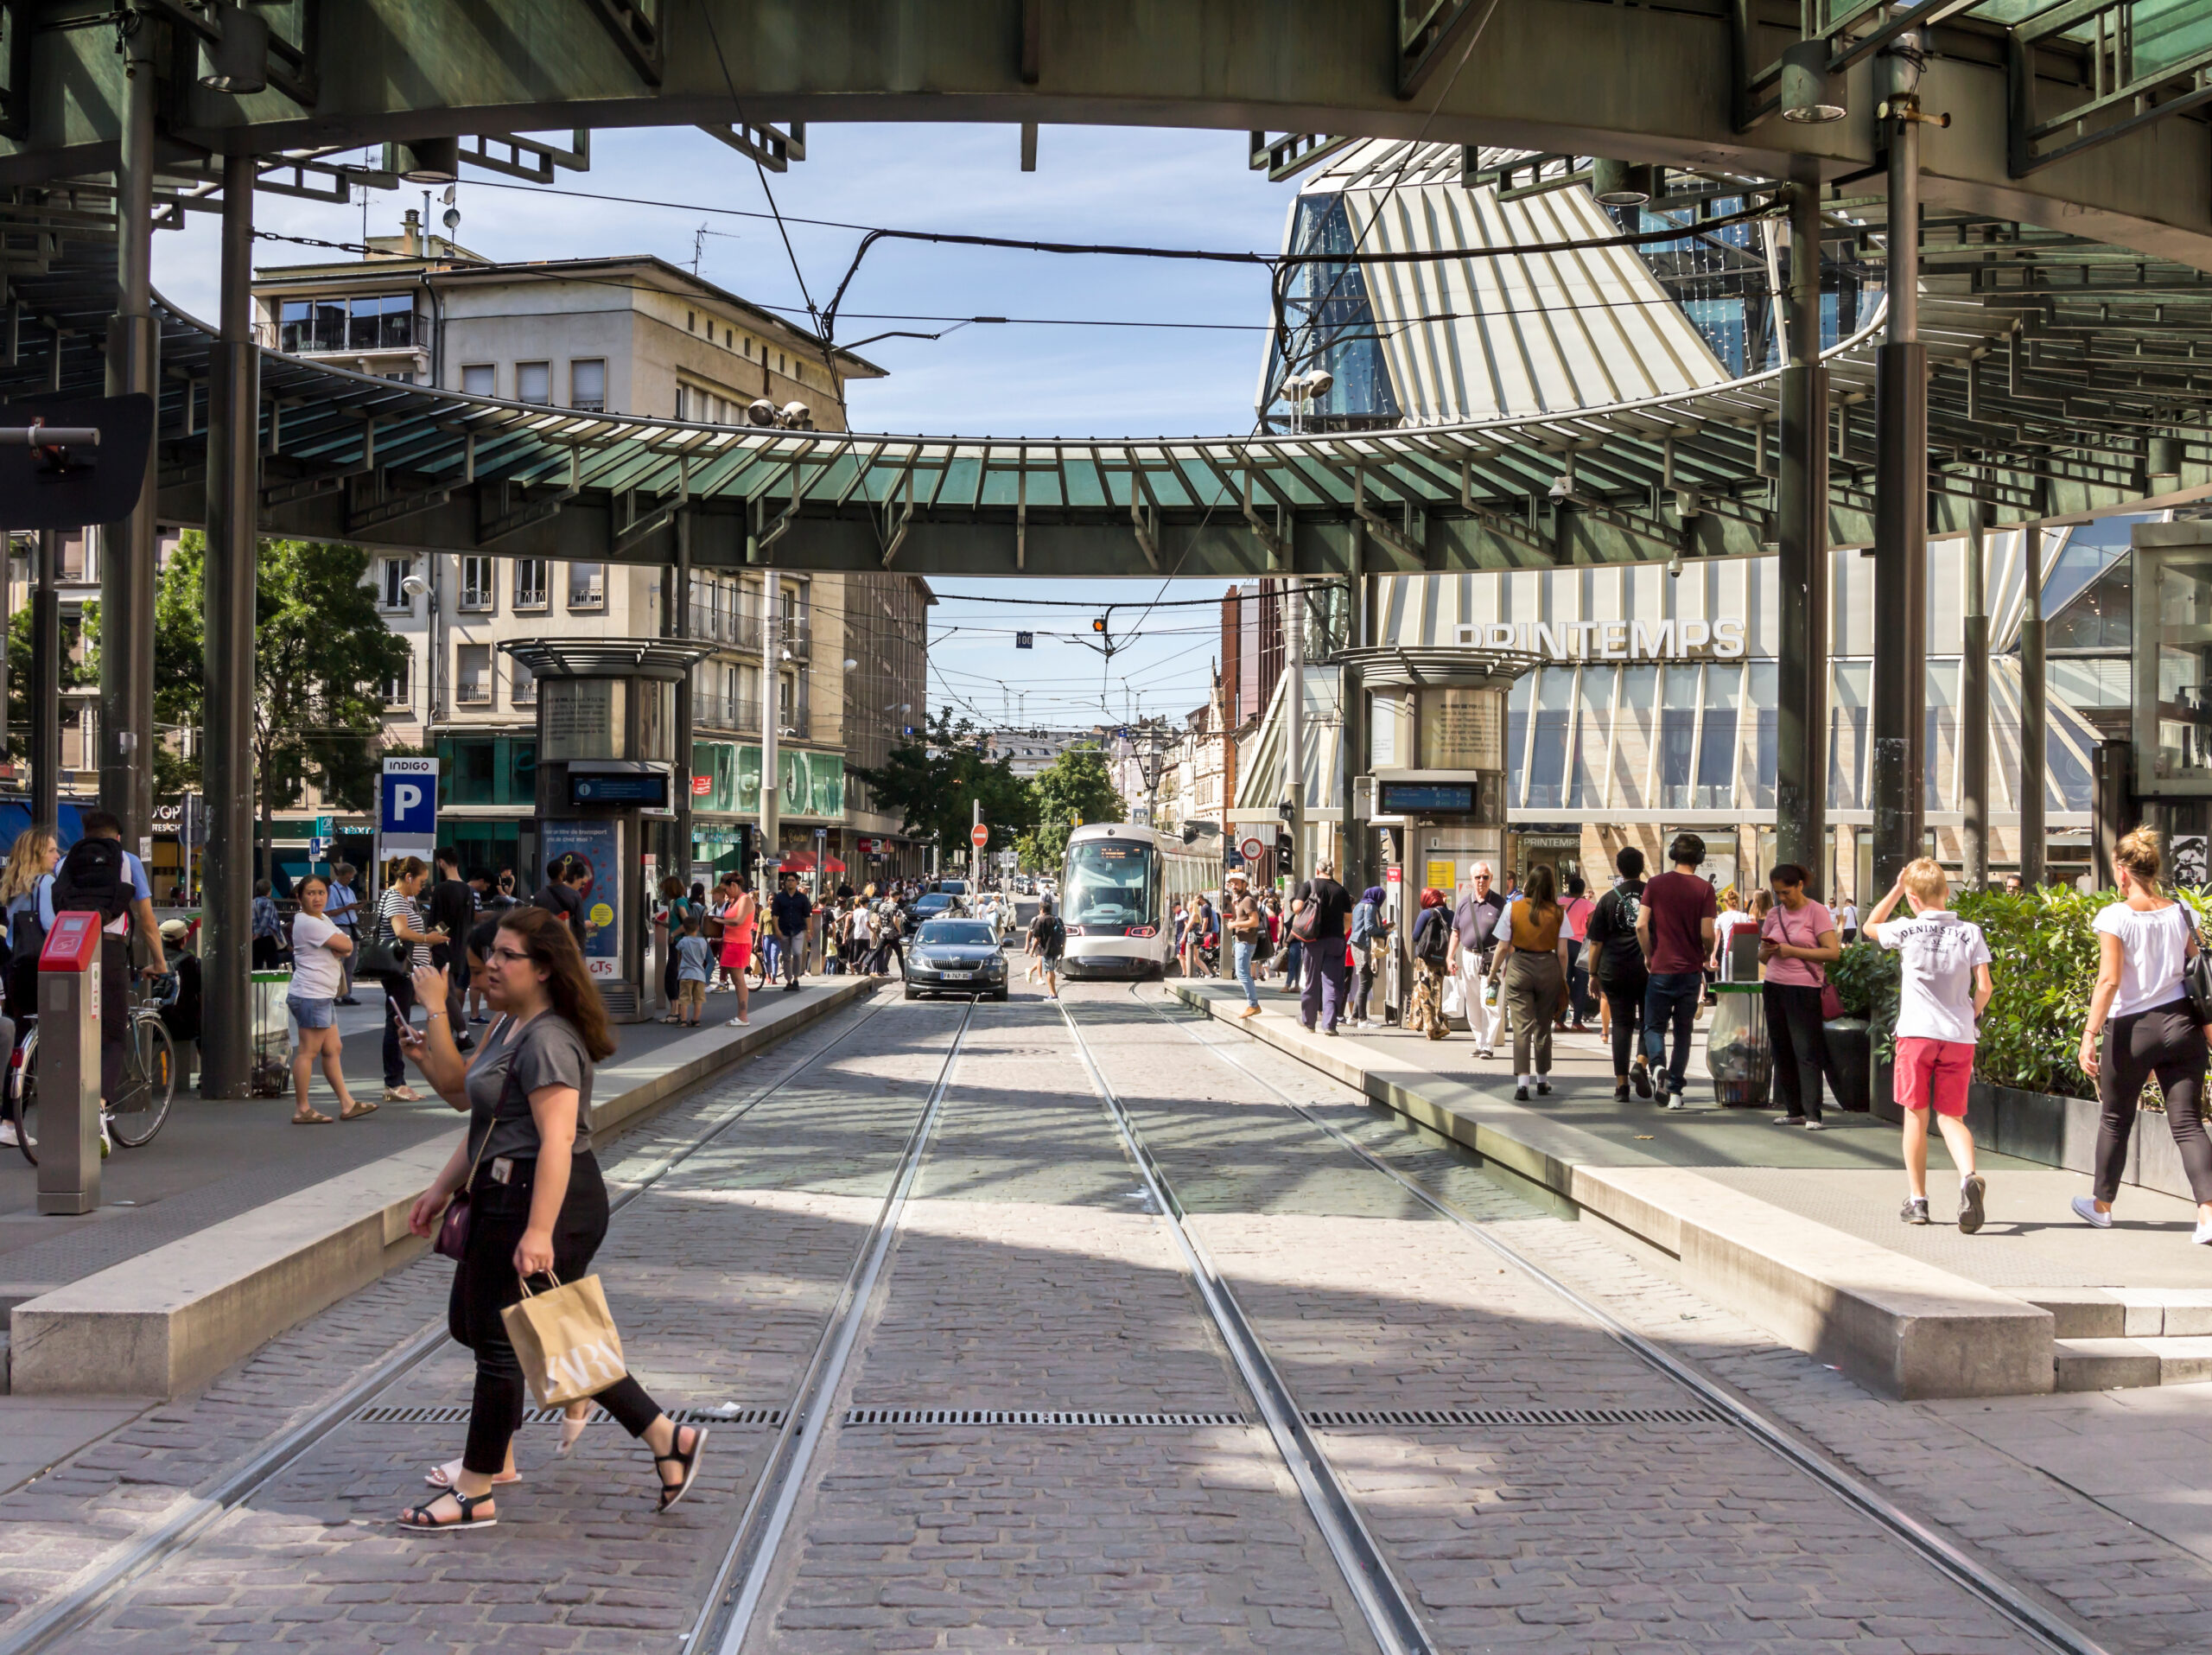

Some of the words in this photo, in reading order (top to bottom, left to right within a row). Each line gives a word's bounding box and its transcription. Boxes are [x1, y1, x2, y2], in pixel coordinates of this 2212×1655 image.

[1017, 635, 1033, 645] 100
[1452, 618, 1745, 660] PRINTEMPS
[389, 761, 429, 772] INDIGO
[394, 784, 423, 821] P
[1523, 837, 1580, 848] PRINTEMPS
[1900, 925, 1938, 939] DENIM
[1940, 926, 1971, 945] STYLE
[589, 960, 613, 974] CTS
